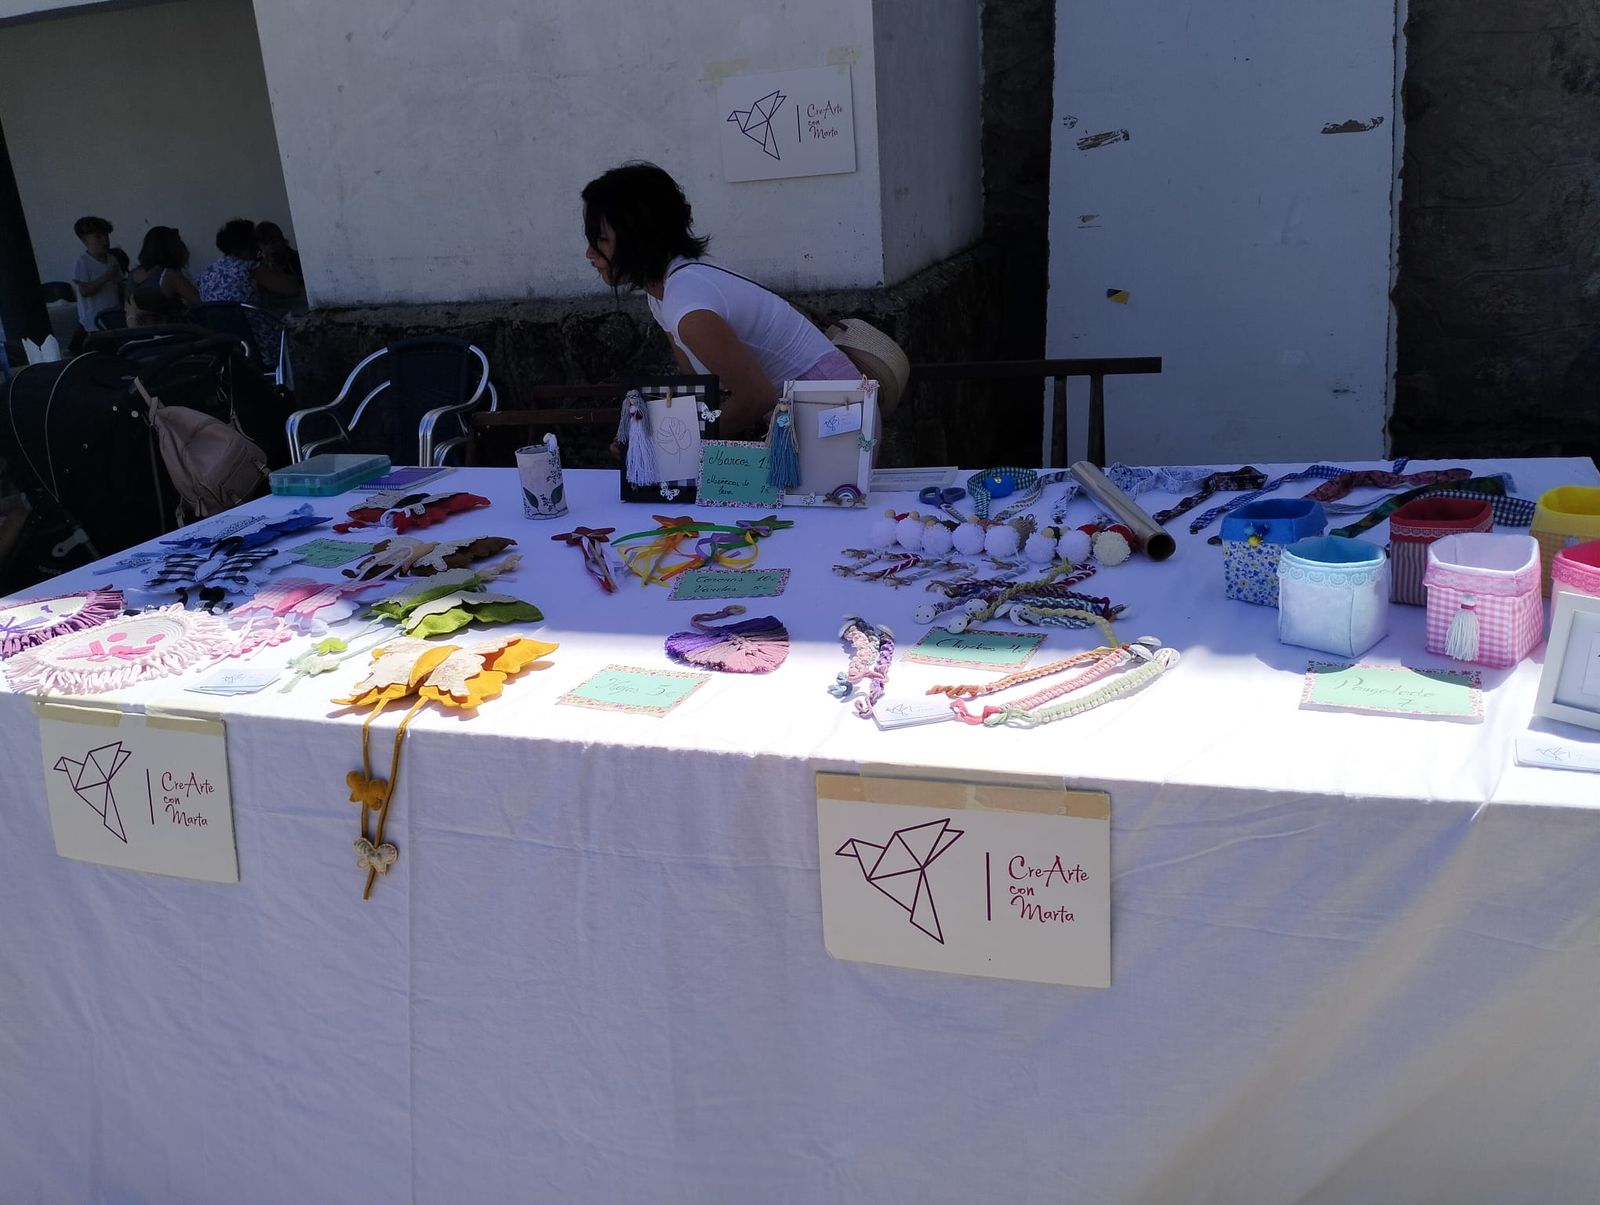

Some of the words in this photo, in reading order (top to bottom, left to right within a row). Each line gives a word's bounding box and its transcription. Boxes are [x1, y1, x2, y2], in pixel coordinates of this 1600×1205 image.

[807, 100, 842, 119] CreArte
[809, 126, 838, 139] Marta
[708, 450, 751, 467] Marcos
[162, 771, 215, 798] CreArte
[163, 796, 180, 804] con
[165, 803, 208, 827] Marta
[1008, 855, 1089, 887] CreArte
[1009, 885, 1035, 896] con
[1010, 895, 1075, 923] Marta
